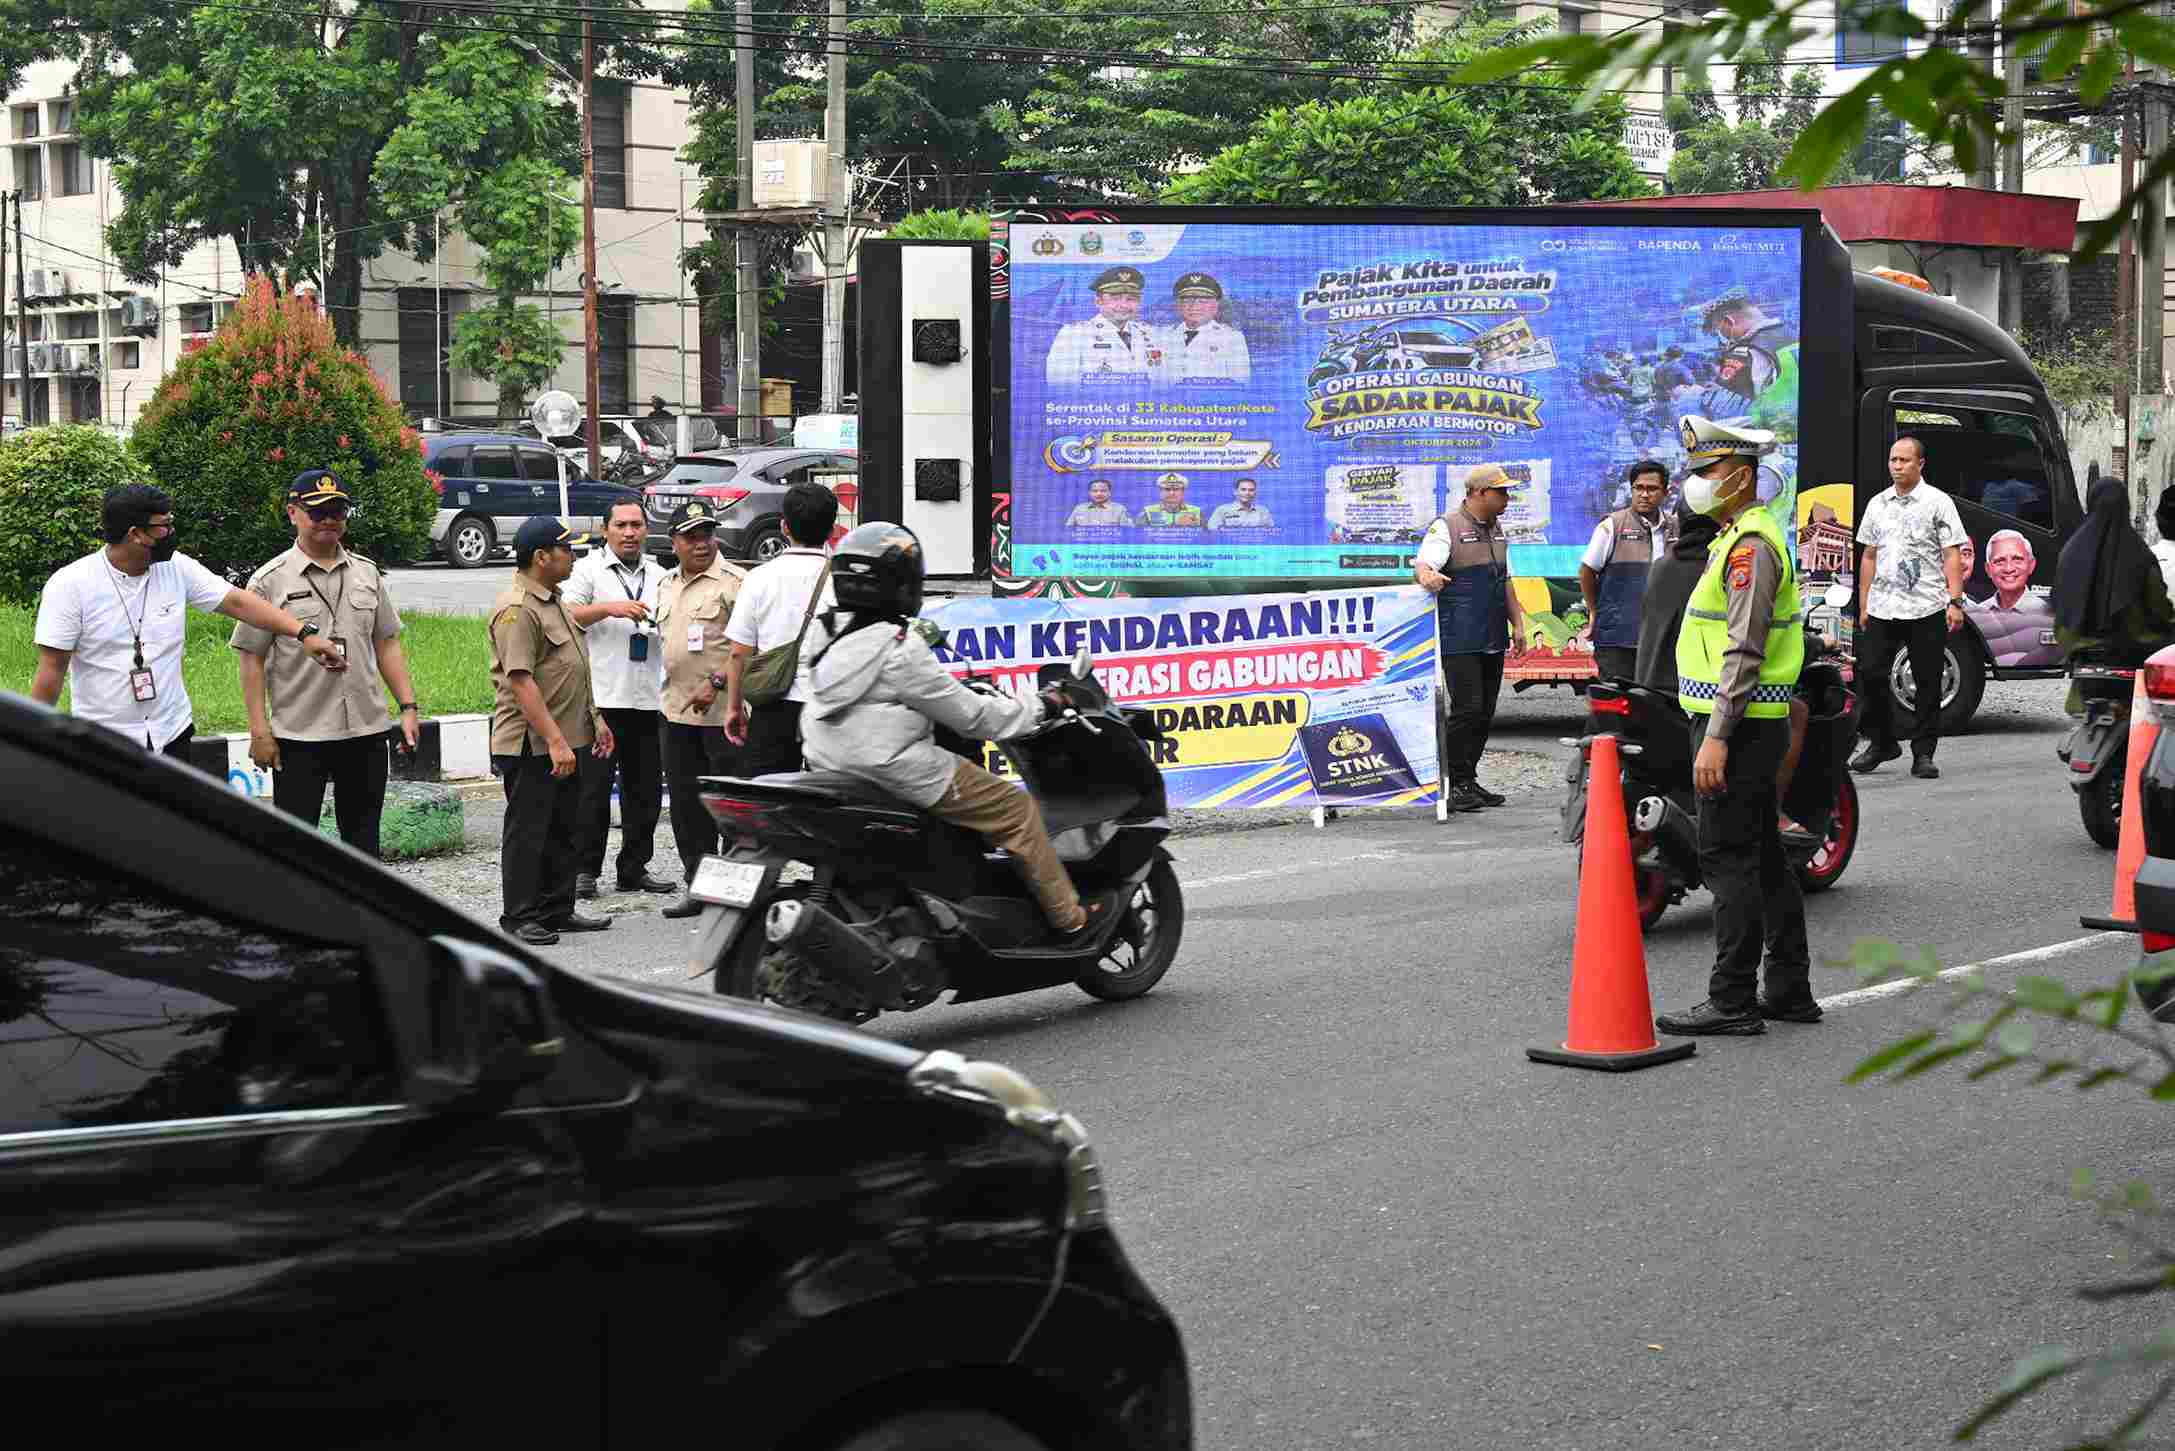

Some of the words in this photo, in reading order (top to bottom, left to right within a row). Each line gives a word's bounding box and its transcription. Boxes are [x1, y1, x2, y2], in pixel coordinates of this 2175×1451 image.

[1638, 239, 1701, 250] BAPENDA
[1319, 263, 1393, 289] Pajak
[1401, 259, 1458, 281] Kita
[1464, 261, 1521, 275] untuk
[1302, 277, 1464, 305] Pembangunan
[1467, 273, 1553, 291] Daerah
[1329, 298, 1440, 320] SUMATERA
[1444, 296, 1518, 312] UTARA
[1326, 372, 1411, 394] OPERASI
[1415, 371, 1523, 394] GABUNGAN
[1046, 403, 1112, 413] Serentak
[1117, 403, 1130, 413] di
[1136, 402, 1154, 413] 33
[1320, 391, 1428, 419] SADAR
[1433, 391, 1531, 419] PAJAK
[1046, 416, 1127, 426] se-Provinsi
[1131, 416, 1201, 426] Sumatera
[1206, 416, 1247, 426] Utara
[1333, 416, 1429, 437] KENDARAAN
[1434, 416, 1517, 435] BERMOTOR
[1111, 434, 1164, 443] Sasaran
[1031, 597, 1375, 658] KENDARAAN!!!
[1188, 648, 1364, 690] GABUNGAN
[1328, 753, 1390, 777] STNK
